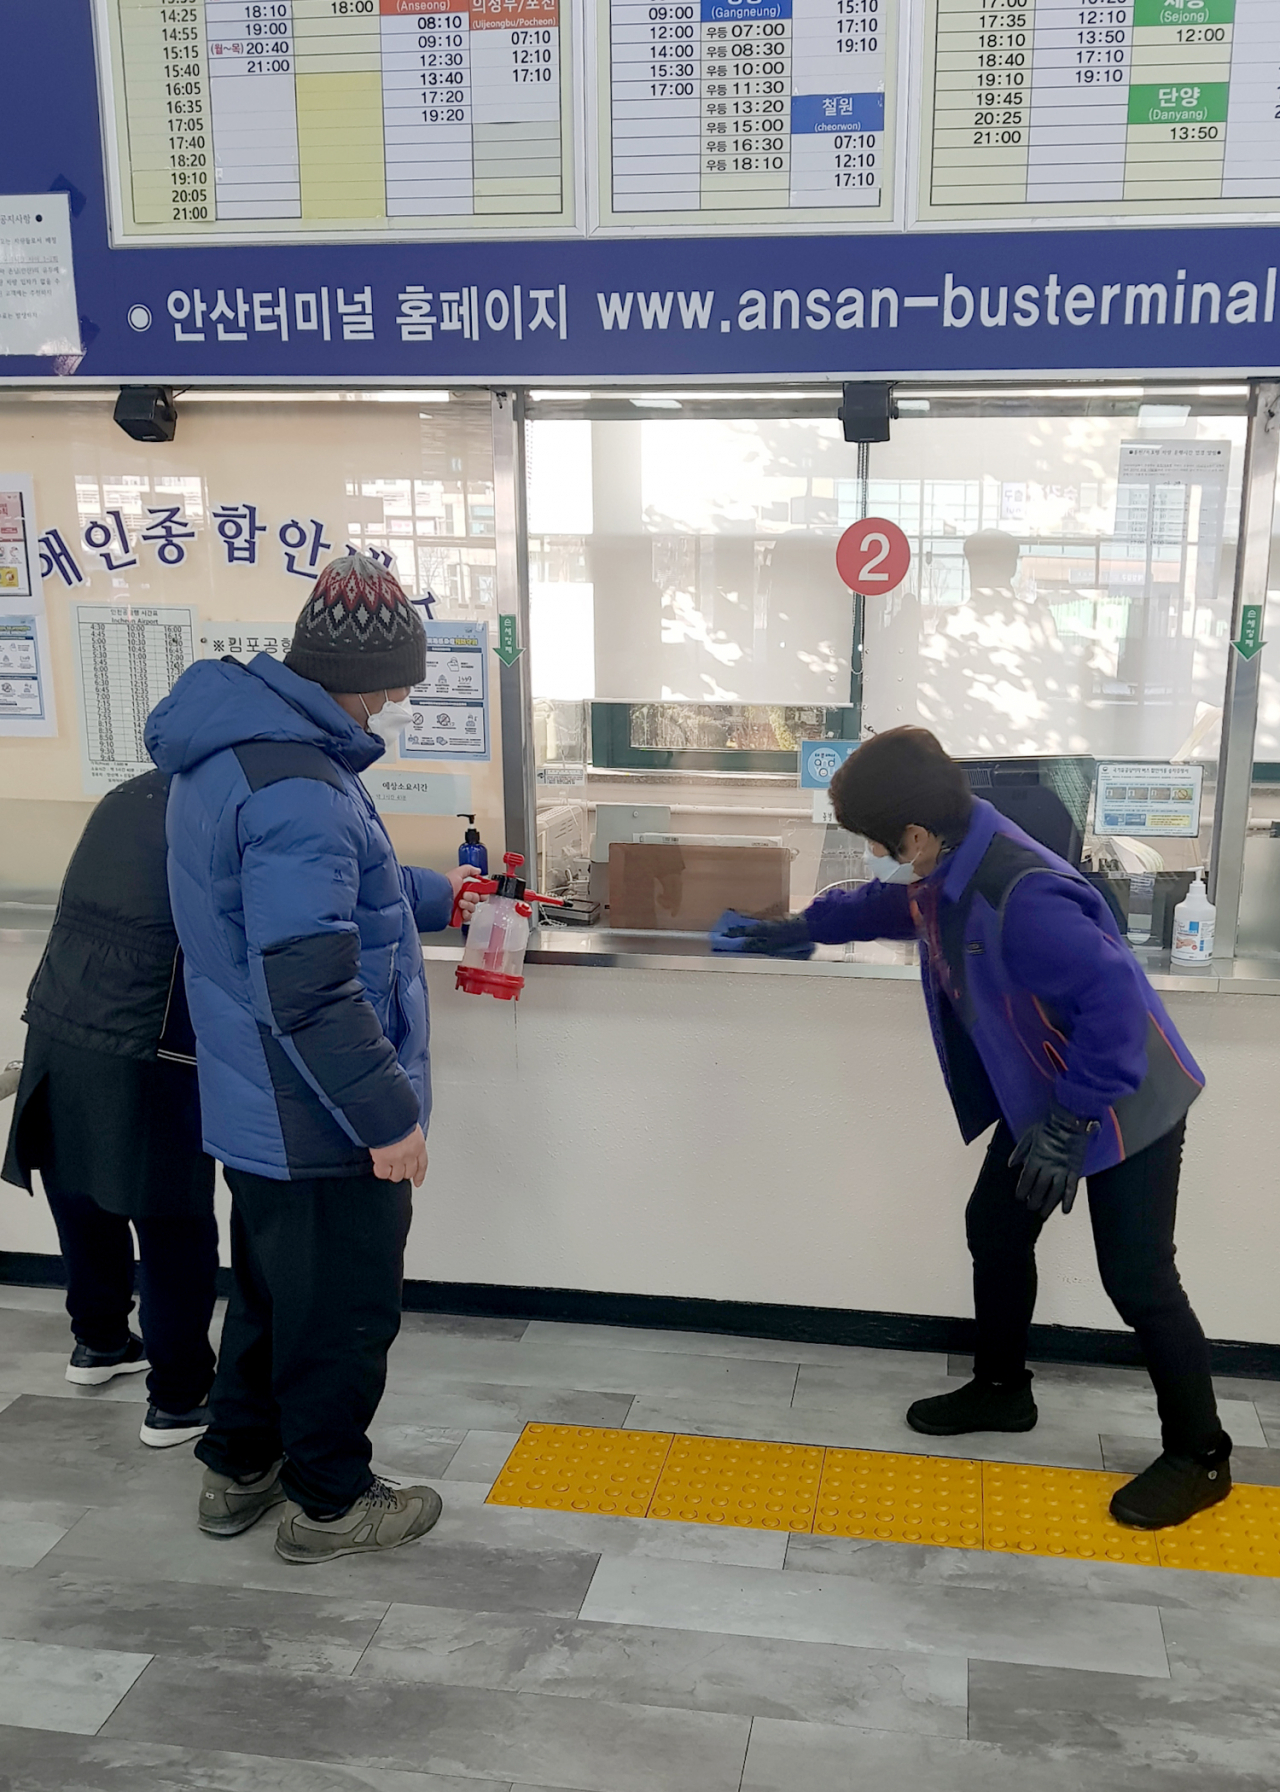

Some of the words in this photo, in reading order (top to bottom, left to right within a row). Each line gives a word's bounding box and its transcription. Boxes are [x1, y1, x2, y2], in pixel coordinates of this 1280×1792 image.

[245, 5, 286, 18] 18:10
[332, 0, 373, 14] 18:00
[397, 0, 450, 11] (Anseong)
[711, 5, 781, 19] (Gangneung)
[838, 0, 878, 13] 15:10
[161, 9, 197, 22] 14:25
[649, 6, 693, 20] 09:00
[1079, 10, 1126, 24] 12:10
[1160, 9, 1209, 23] (Sejong)
[418, 16, 461, 29] 08:10
[472, 18, 556, 30] (Uijeongbu/Pocheon)
[838, 20, 877, 33] 17:10
[980, 14, 1026, 28] 17:35
[162, 27, 197, 41] 14:55
[246, 22, 287, 35] 19:00
[651, 26, 693, 39] 12:00
[732, 23, 785, 37] 07:00
[1177, 28, 1225, 42] 12:00
[418, 35, 462, 48] 09:10
[512, 30, 550, 45] 07:10
[979, 34, 1025, 47] 18:10
[1078, 30, 1125, 44] 13:50
[247, 41, 289, 54] 20:40
[651, 45, 693, 58] 14:00
[732, 42, 784, 56] 08:30
[837, 38, 877, 52] 19:10
[163, 45, 198, 59] 15:15
[513, 49, 551, 63] 12:10
[1077, 50, 1123, 63] 17:10
[248, 60, 289, 72] 21:00
[420, 53, 463, 66] 12:30
[978, 53, 1024, 67] 18:40
[165, 64, 199, 78] 15:40
[513, 68, 551, 82] 17:10
[651, 64, 693, 77] 15:30
[733, 62, 784, 75] 10:00
[421, 72, 463, 85] 13:40
[978, 73, 1024, 86] 19:10
[1076, 69, 1122, 83] 19:10
[166, 82, 200, 95] 16:05
[651, 83, 693, 96] 17:00
[733, 81, 784, 94] 11:30
[422, 90, 463, 103] 17:20
[977, 92, 1022, 106] 19:45
[1159, 87, 1200, 107] 단양
[167, 100, 202, 113] 16:35
[733, 100, 784, 113] 13:20
[823, 98, 853, 116] 철원
[422, 109, 464, 122] 19:20
[975, 112, 1021, 125] 20:25
[1149, 108, 1207, 120] (Danyang)
[168, 118, 203, 131] 17:05
[733, 119, 783, 132] 15:00
[814, 121, 861, 132] (cheorwon)
[974, 131, 1021, 144] 21:00
[1171, 126, 1218, 140] 13:50
[169, 136, 205, 149] 17:40
[733, 138, 783, 151] 16:30
[835, 134, 875, 149] 07:10
[170, 154, 206, 167] 18:20
[733, 157, 783, 170] 18:10
[835, 154, 875, 168] 12:10
[172, 172, 207, 185] 19:10
[835, 173, 874, 186] 17:10
[172, 189, 206, 202] 20:05
[173, 206, 207, 220] 21:00
[167, 286, 374, 341] 안산터미널
[396, 284, 567, 341] 홈페이지
[858, 533, 890, 581] 2
[382, 782, 428, 792] 예상소요시간
